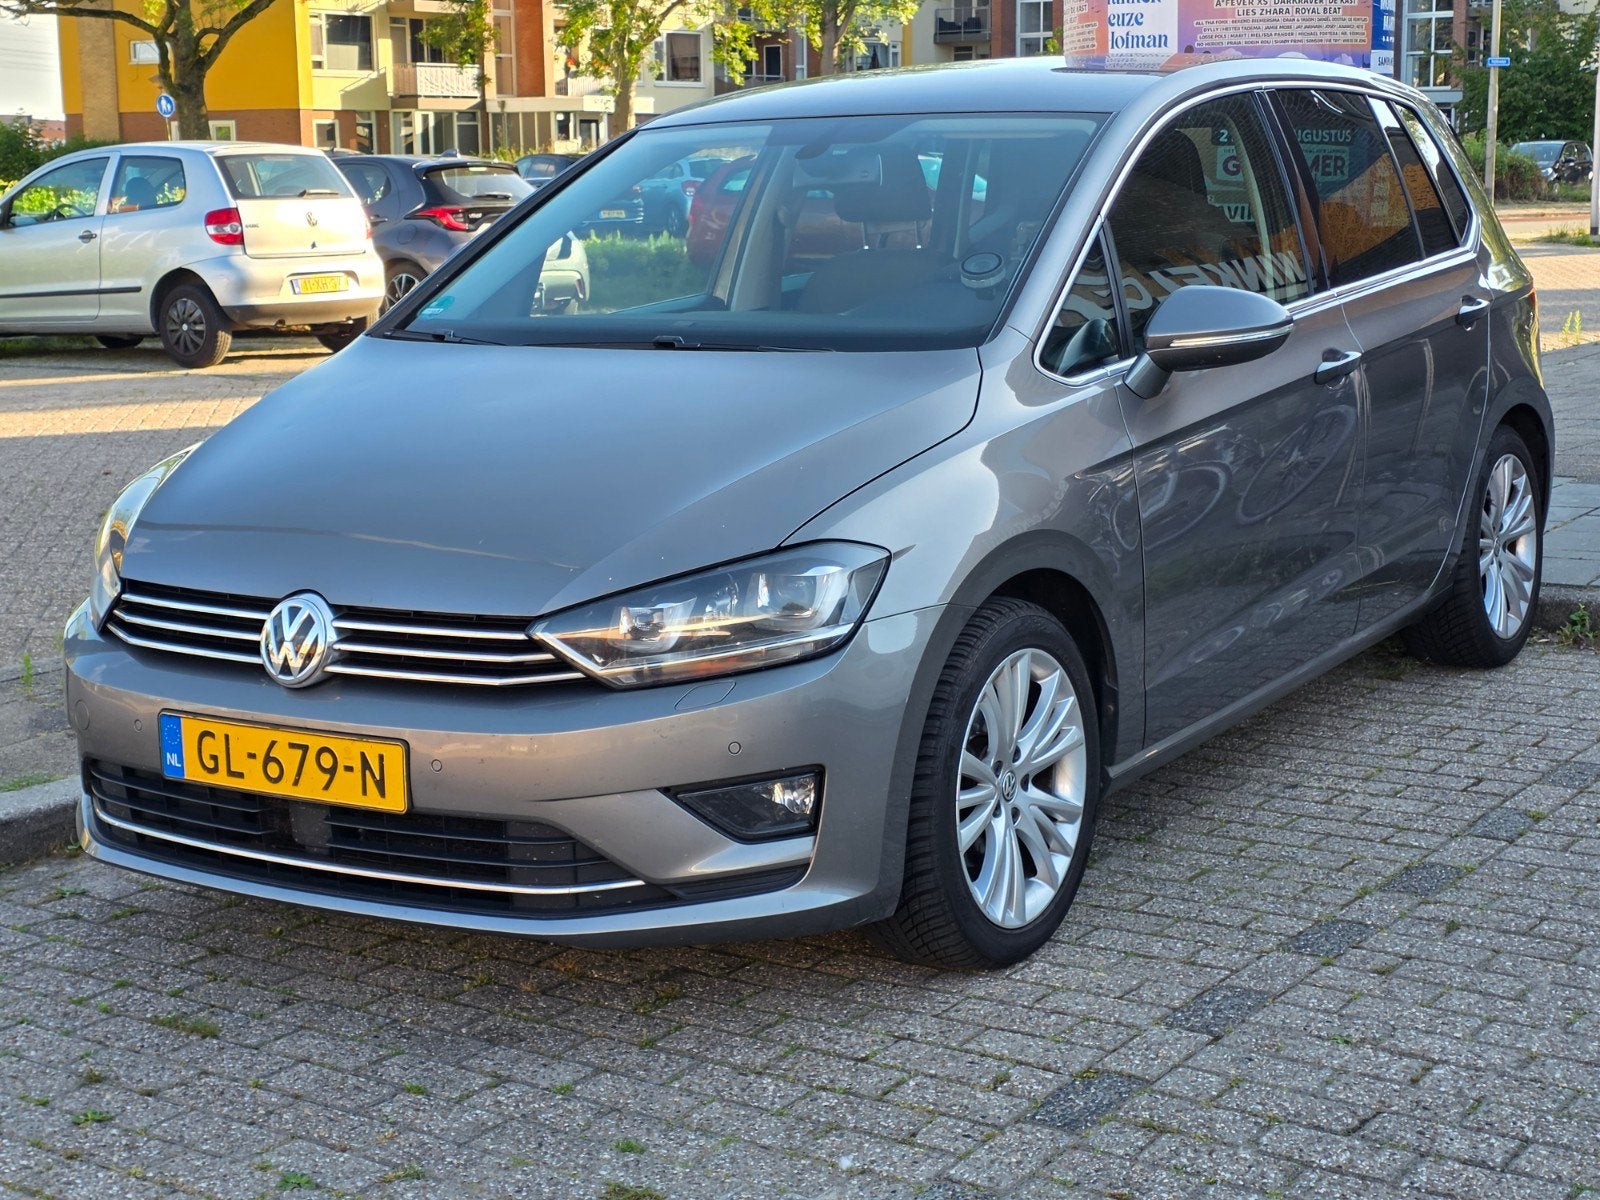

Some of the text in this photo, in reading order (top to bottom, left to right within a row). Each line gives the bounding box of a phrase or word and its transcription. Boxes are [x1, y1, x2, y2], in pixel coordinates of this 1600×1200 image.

[1237, 8, 1257, 16] LIES
[1259, 7, 1290, 16] ZHARA
[1295, 7, 1320, 15] ROYAL
[166, 752, 182, 767] NL
[197, 730, 386, 799] GL-679-N
